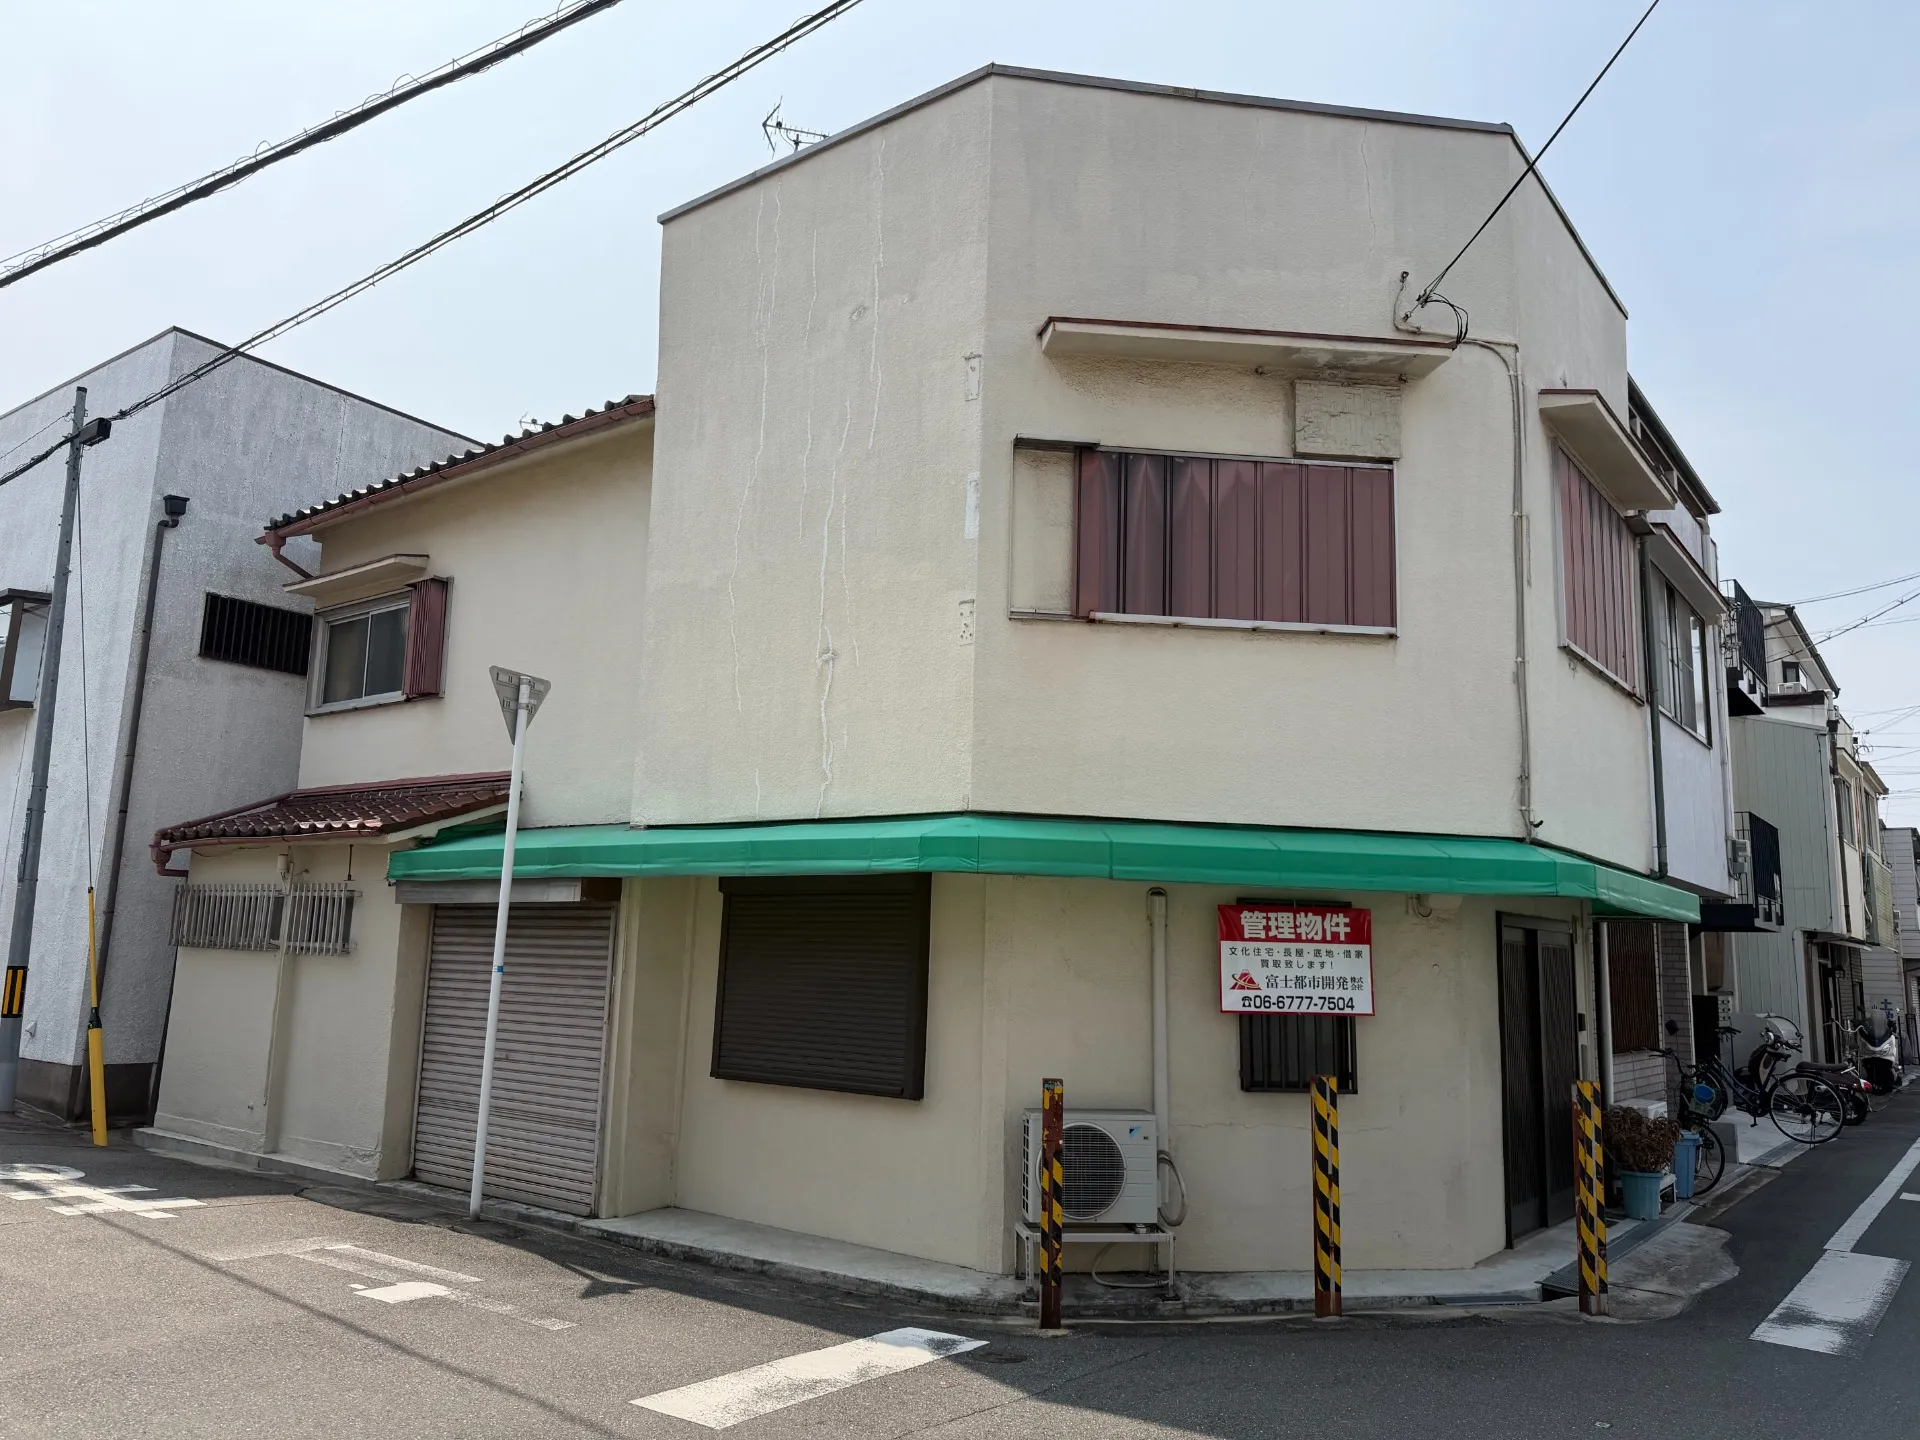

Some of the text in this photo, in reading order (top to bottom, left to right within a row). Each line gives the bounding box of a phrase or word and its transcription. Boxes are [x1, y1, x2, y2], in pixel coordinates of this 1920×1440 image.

[1240, 911, 1351, 941] 管理物件
[1253, 995, 1355, 1011] 06-6777-7504
